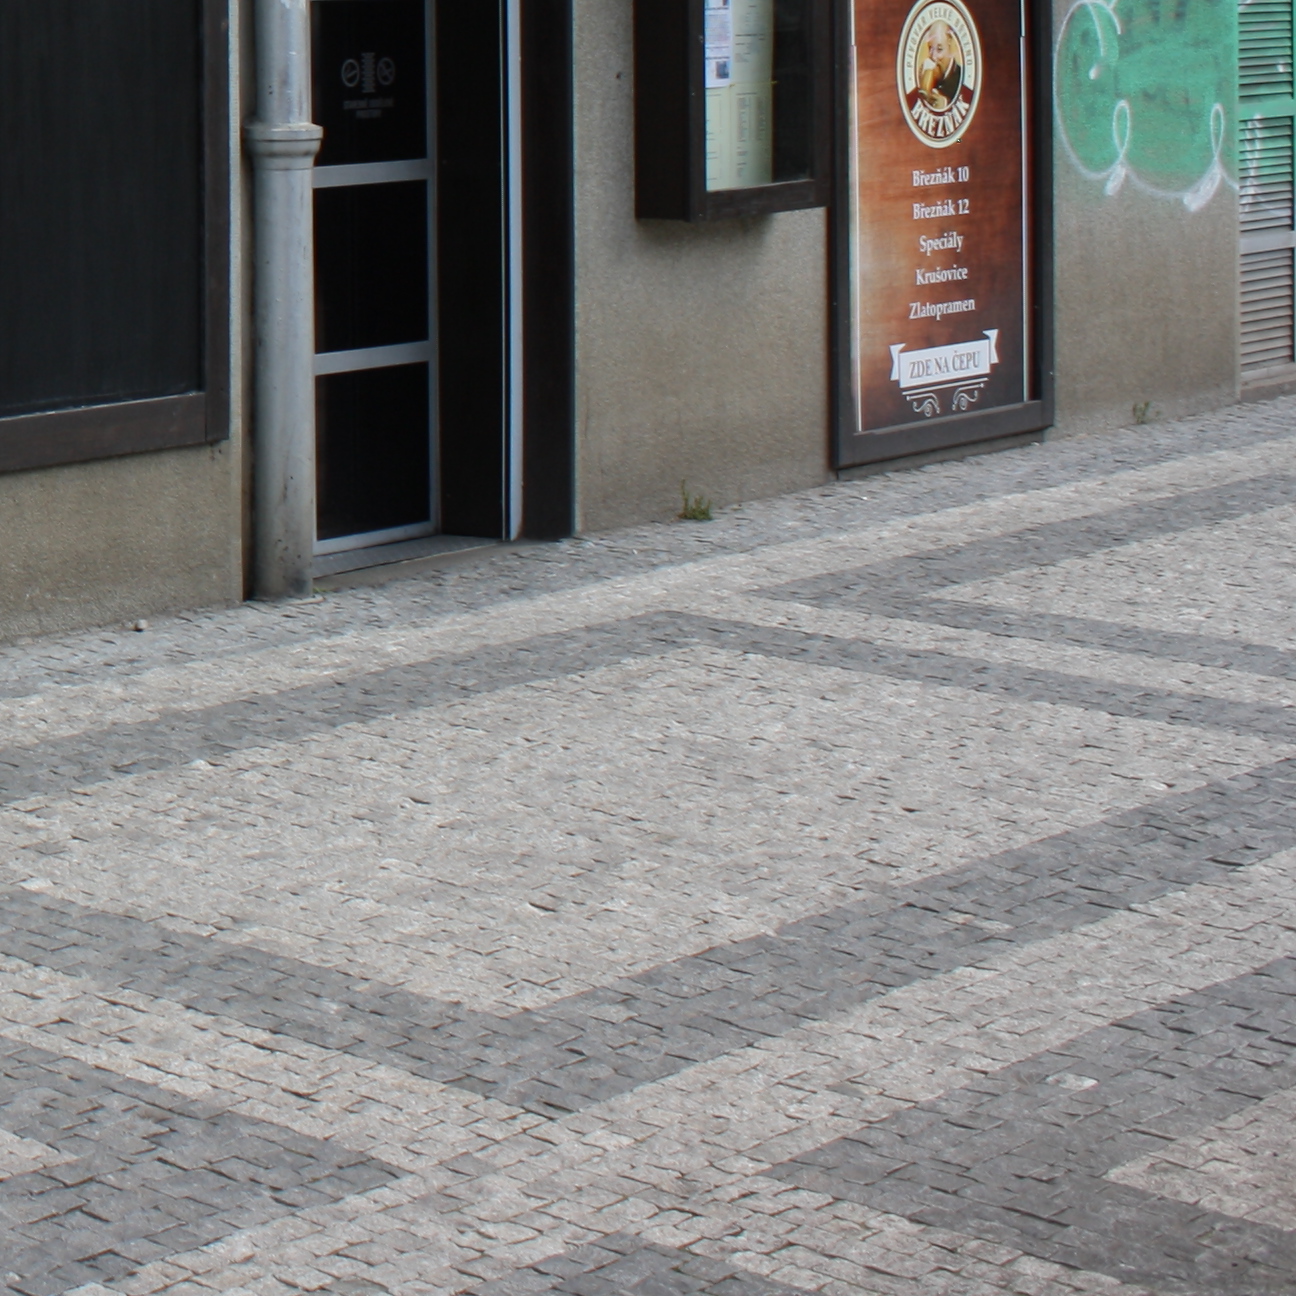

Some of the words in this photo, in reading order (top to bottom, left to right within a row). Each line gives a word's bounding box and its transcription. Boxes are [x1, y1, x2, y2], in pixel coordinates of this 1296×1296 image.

[911, 95, 970, 138] BŘEZŇÁK
[912, 167, 955, 187] Březňák
[957, 166, 969, 182] 10
[912, 200, 955, 220] Březňák
[957, 199, 969, 215] 12
[919, 232, 964, 256] Speciály
[916, 264, 968, 285] Krušovice
[909, 298, 975, 321] Zlatopramen
[909, 358, 932, 379] ZDE
[934, 355, 950, 375] NA
[952, 350, 980, 373] ČEPU
